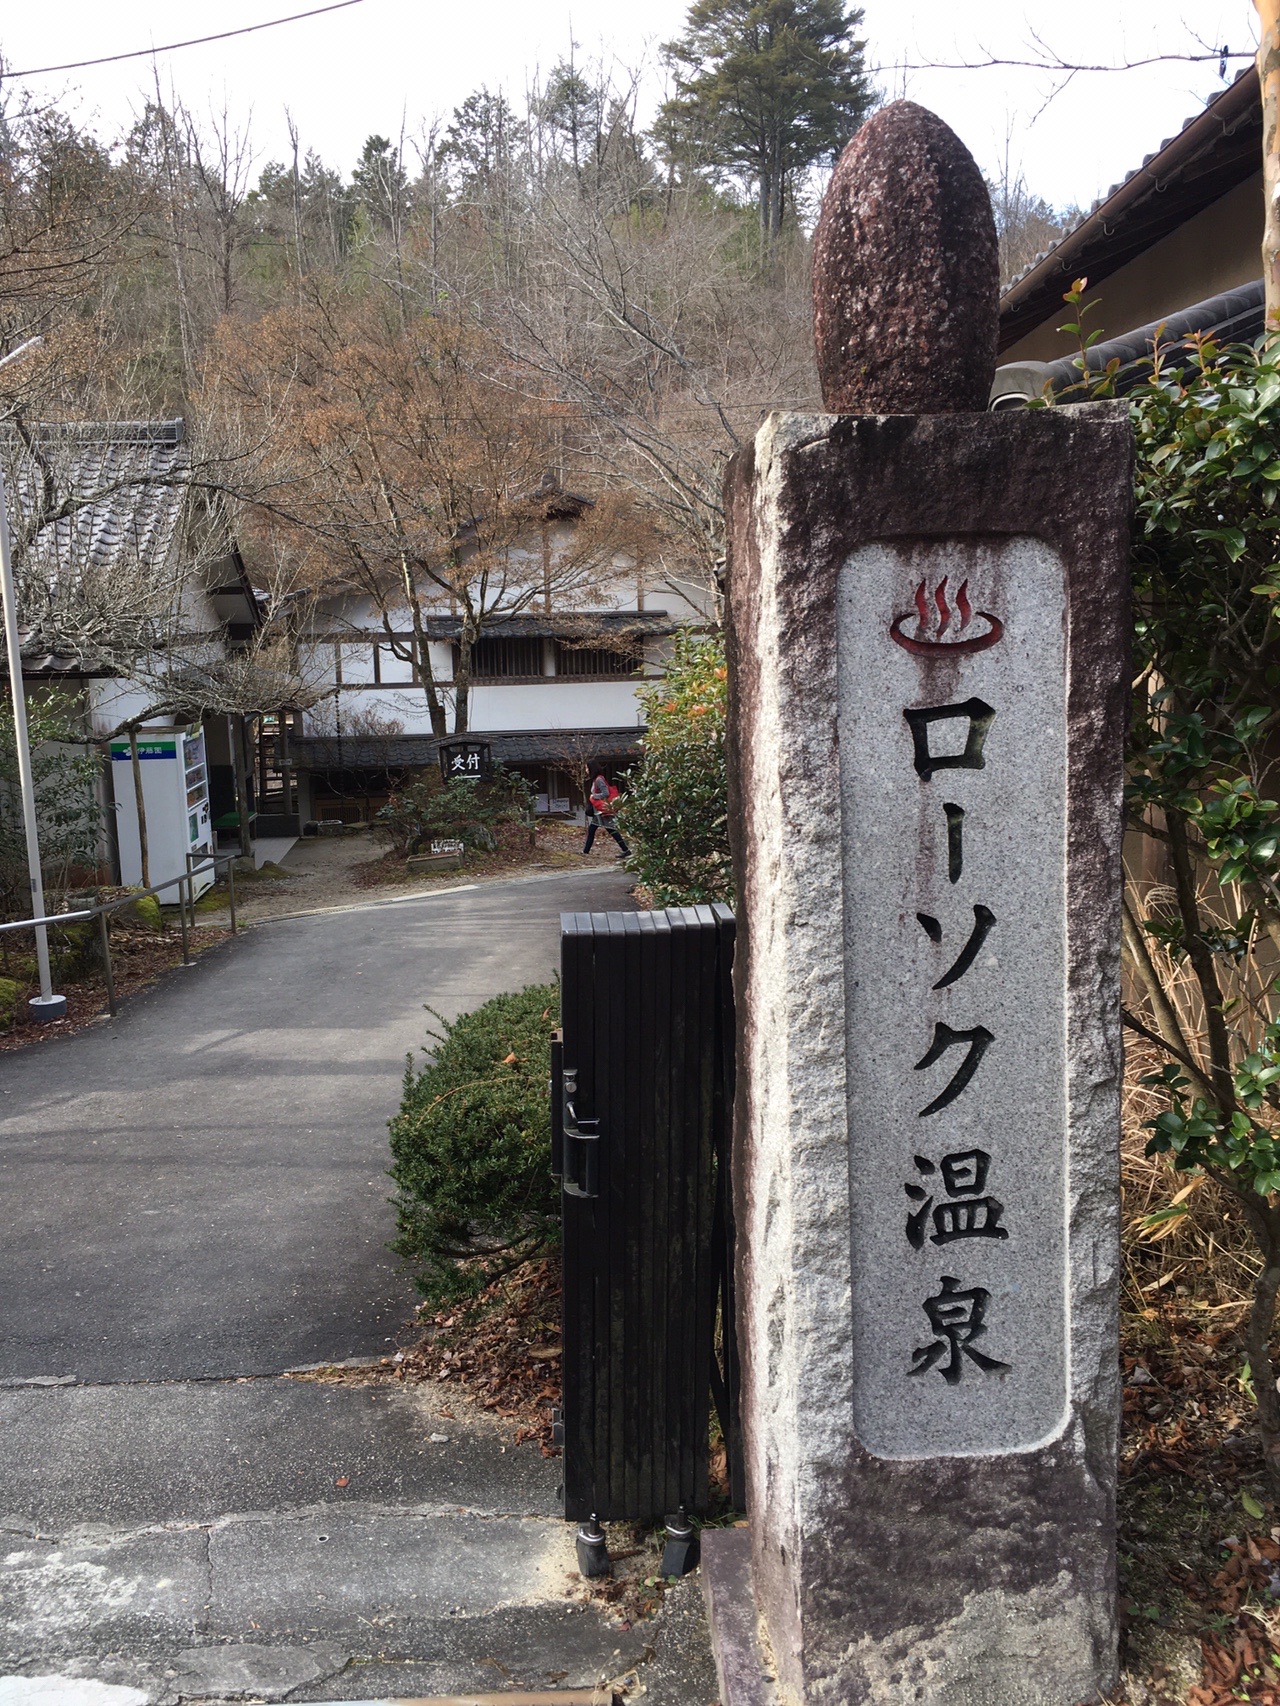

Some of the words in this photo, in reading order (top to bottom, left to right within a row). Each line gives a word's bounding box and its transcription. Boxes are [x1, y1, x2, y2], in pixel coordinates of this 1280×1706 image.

[451, 753, 481, 770] 受付
[903, 697, 1010, 1385] ローソク温泉
